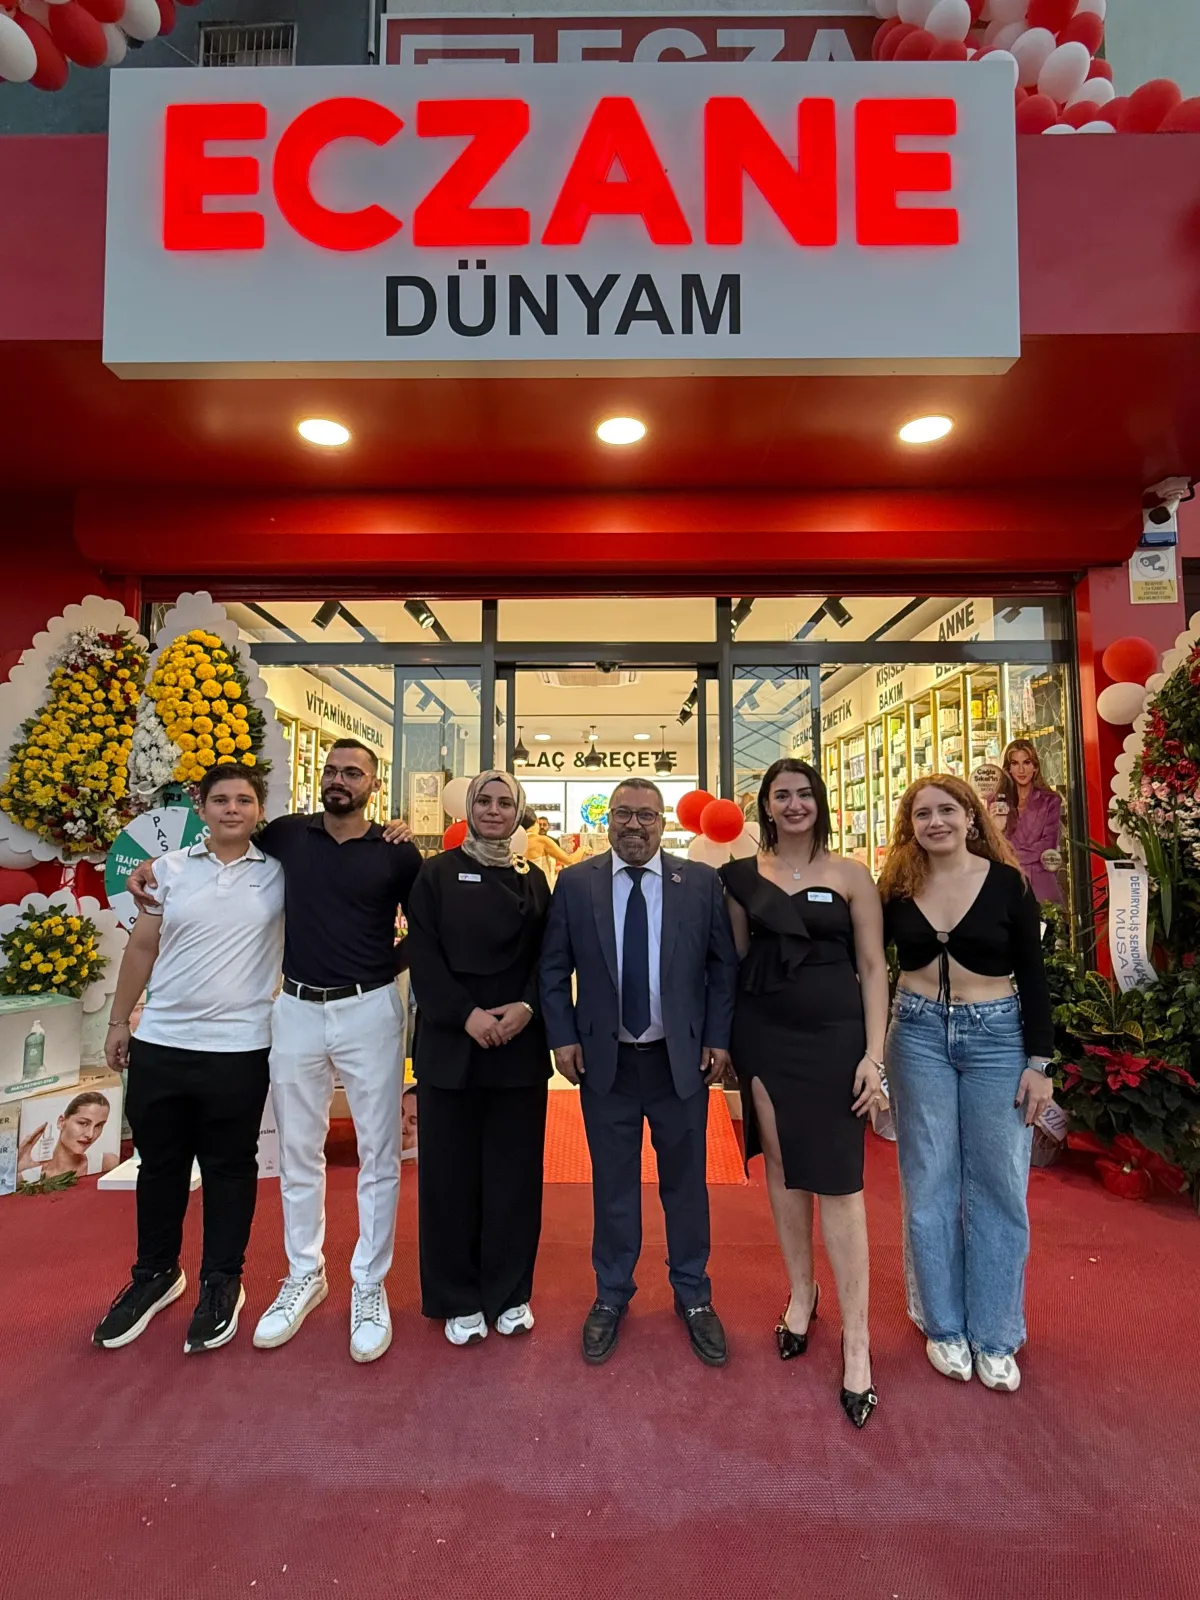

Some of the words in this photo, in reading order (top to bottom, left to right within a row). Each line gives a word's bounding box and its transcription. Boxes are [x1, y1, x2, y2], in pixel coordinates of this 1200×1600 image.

[163, 96, 960, 250] ECZANE
[385, 259, 741, 337] DÜNYAM
[938, 601, 975, 641] ANNE
[306, 690, 384, 748] VİTAMİN&MİNERAL
[879, 682, 904, 711] BAKIM
[792, 699, 852, 751] DERMOZMETİK
[517, 751, 565, 772] LAÇ
[573, 752, 585, 768] &
[152, 815, 169, 852] PAS
[115, 853, 143, 868] DİYE!
[116, 865, 134, 876] PRİ
[1127, 876, 1140, 932] DEMİRYOL-İŞ
[1115, 909, 1129, 969] MUSA
